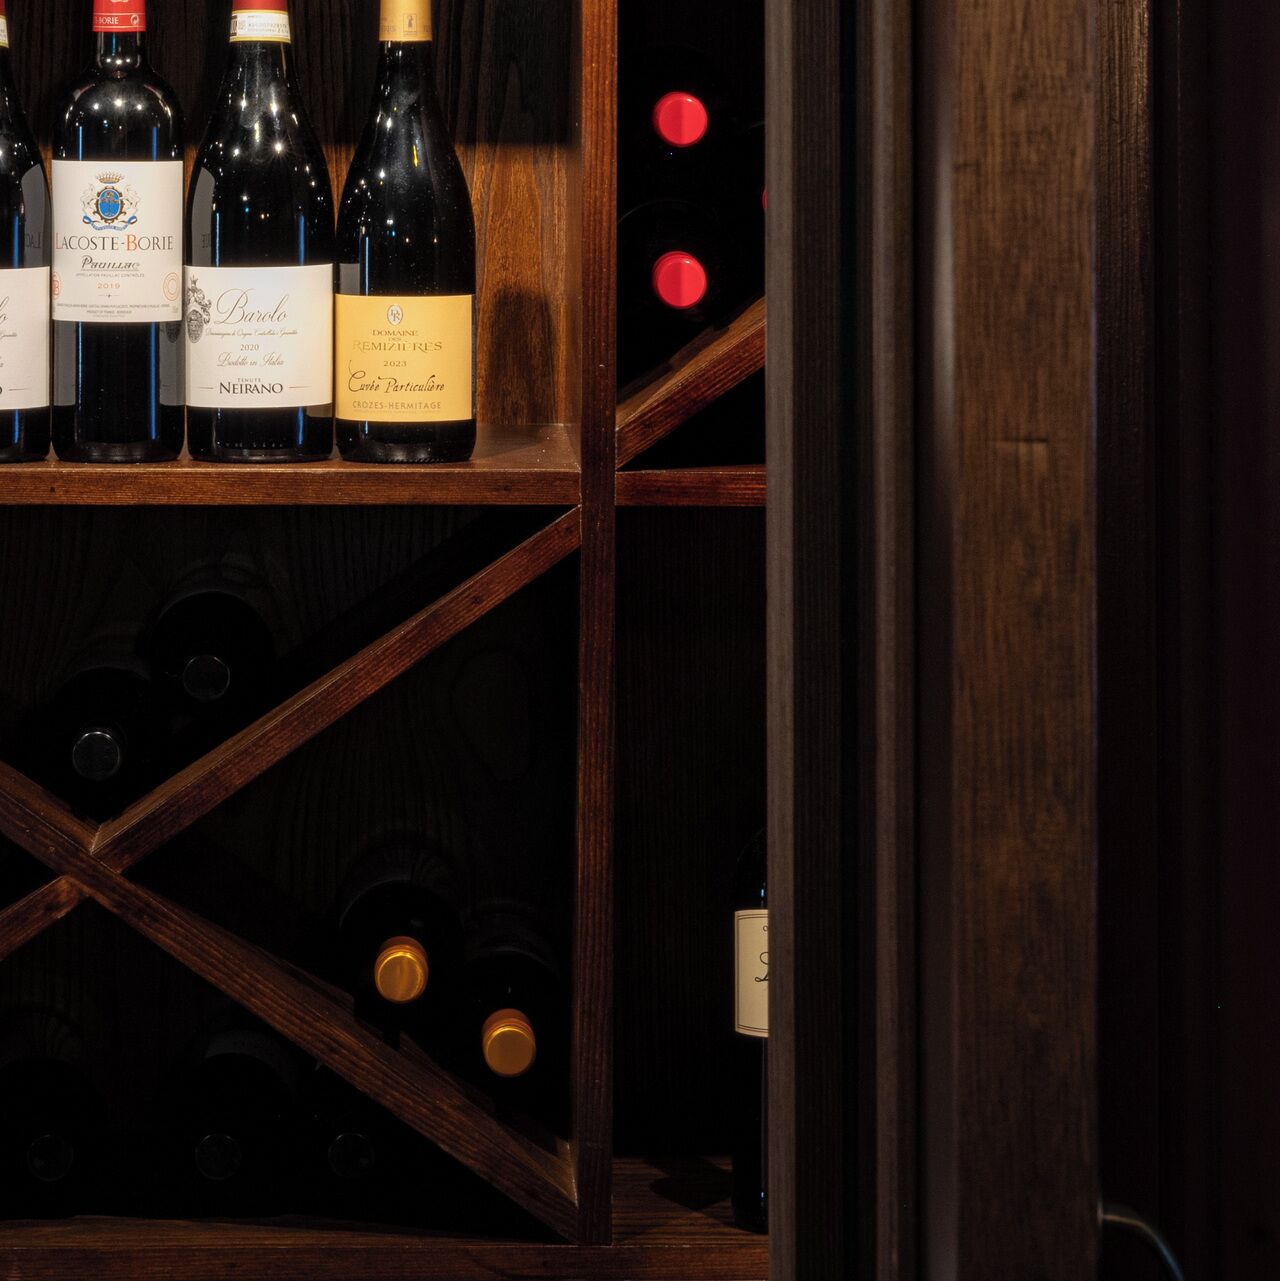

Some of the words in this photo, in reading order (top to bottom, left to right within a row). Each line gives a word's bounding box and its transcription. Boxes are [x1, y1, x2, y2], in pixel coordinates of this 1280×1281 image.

[55, 232, 174, 251] LACOSTE-BORIE
[213, 288, 289, 325] Barolo
[372, 329, 419, 337] DOMAINE
[348, 359, 380, 393] Cuvée
[377, 374, 445, 394] Particulière
[219, 381, 284, 395] NEIRANO
[352, 400, 442, 410] CROZES-HERMITAGE
